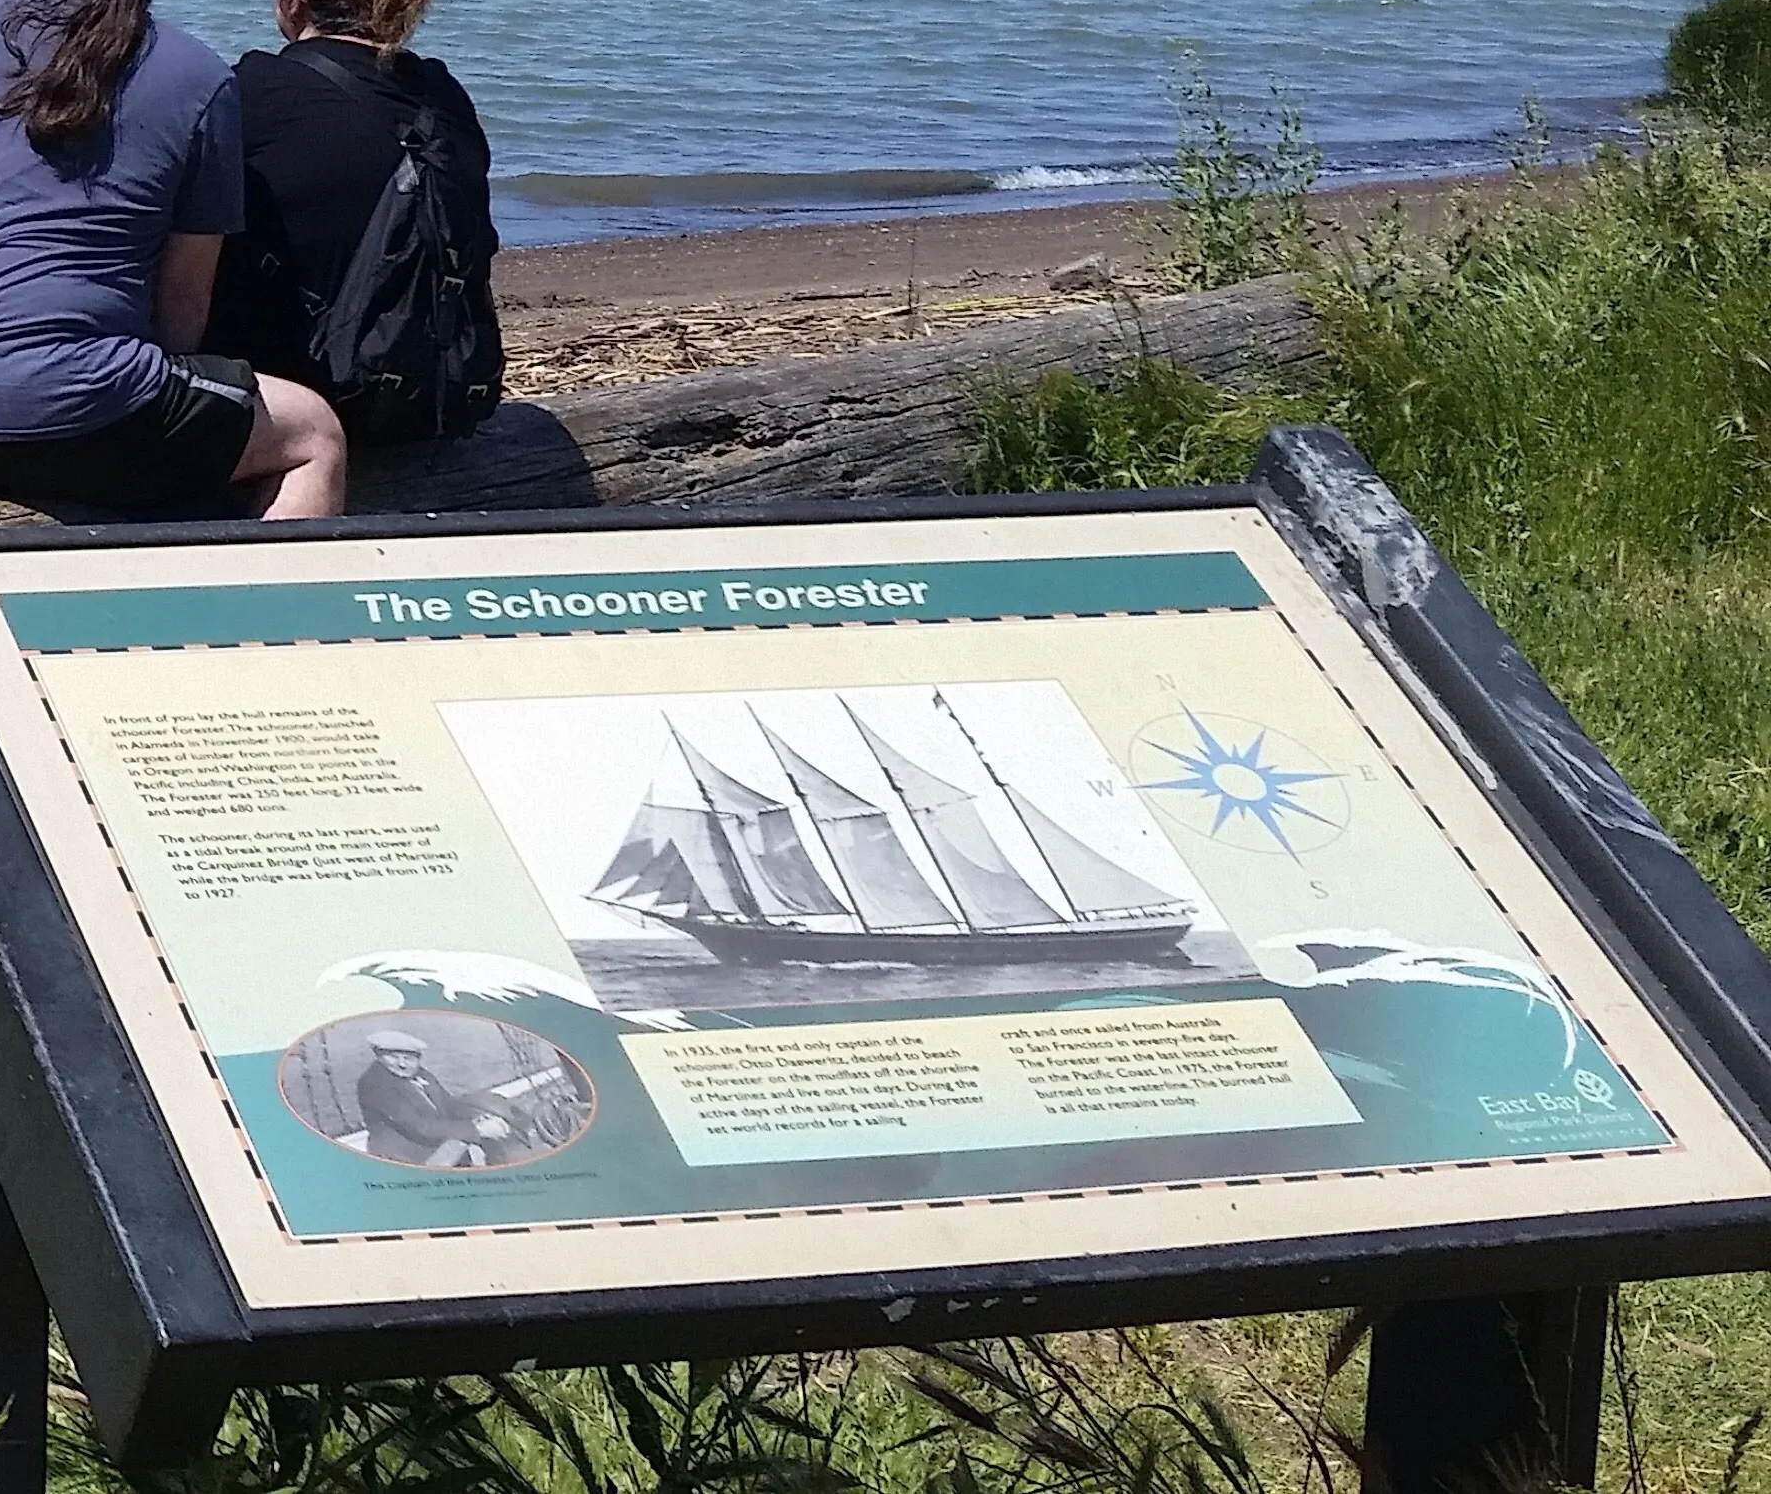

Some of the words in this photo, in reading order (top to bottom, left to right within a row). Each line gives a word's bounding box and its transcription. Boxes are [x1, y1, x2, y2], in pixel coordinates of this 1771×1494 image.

[354, 591, 453, 624] The
[468, 584, 709, 620] Schooner
[720, 578, 931, 613] Forester
[219, 712, 239, 720] the
[1358, 764, 1379, 782] E
[1086, 780, 1114, 798] W
[159, 834, 184, 844] The
[411, 824, 441, 833] used
[266, 843, 311, 853] around
[316, 843, 336, 851] the
[341, 842, 371, 850] main
[172, 863, 193, 871] the
[267, 857, 308, 868] Bridge
[178, 876, 213, 885] while
[217, 875, 238, 883] the
[241, 873, 283, 884] bridge
[315, 870, 352, 880] being
[386, 867, 418, 875] from
[185, 891, 200, 899] to
[1310, 880, 1328, 899] S
[1033, 1027, 1057, 1037] and
[1132, 1022, 1163, 1031] from
[1166, 1018, 1221, 1029] Australia
[663, 1048, 677, 1057] In
[721, 1046, 741, 1055] the
[745, 1044, 774, 1054] first
[777, 1041, 800, 1052] and
[804, 1041, 831, 1051] only
[835, 1038, 881, 1050] captain
[885, 1036, 897, 1046] of
[902, 1037, 924, 1045] the
[851, 1053, 901, 1064] decided
[904, 1052, 919, 1060] to
[922, 1048, 961, 1059] beach
[1009, 1046, 1024, 1054] to
[1027, 1043, 1051, 1053] San
[1052, 1040, 1114, 1051] Francisco
[1016, 1059, 1044, 1069] The
[1046, 1057, 1100, 1067] Forester
[1132, 1052, 1155, 1061] the
[1222, 1045, 1278, 1056] schooner
[681, 1079, 703, 1088] the
[707, 1076, 763, 1086] Forester
[789, 1074, 811, 1082] the
[895, 1068, 917, 1076] the
[921, 1064, 979, 1075] shoreline
[1028, 1075, 1045, 1084] on
[1048, 1073, 1070, 1082] the
[1072, 1069, 1114, 1081] Pacific
[1212, 1063, 1234, 1072] the
[1235, 1060, 1288, 1070] Forester
[690, 1094, 704, 1103] of
[771, 1089, 794, 1099] and
[824, 1088, 847, 1096] out
[906, 1082, 954, 1092] During
[955, 1079, 978, 1088] the
[1035, 1087, 1084, 1099] burned
[1086, 1087, 1101, 1096] to
[1104, 1085, 1126, 1094] the
[1190, 1078, 1218, 1088] The
[1219, 1076, 1266, 1087] burned
[699, 1109, 737, 1119] active
[741, 1107, 770, 1119] days
[774, 1105, 787, 1114] of
[791, 1104, 813, 1113] the
[905, 1099, 926, 1107] the
[929, 1095, 983, 1105] Forester
[1478, 1096, 1535, 1115] East
[1535, 1091, 1581, 1114] Bay
[731, 1122, 771, 1133] world
[775, 1119, 826, 1131] records
[829, 1118, 849, 1127] for
